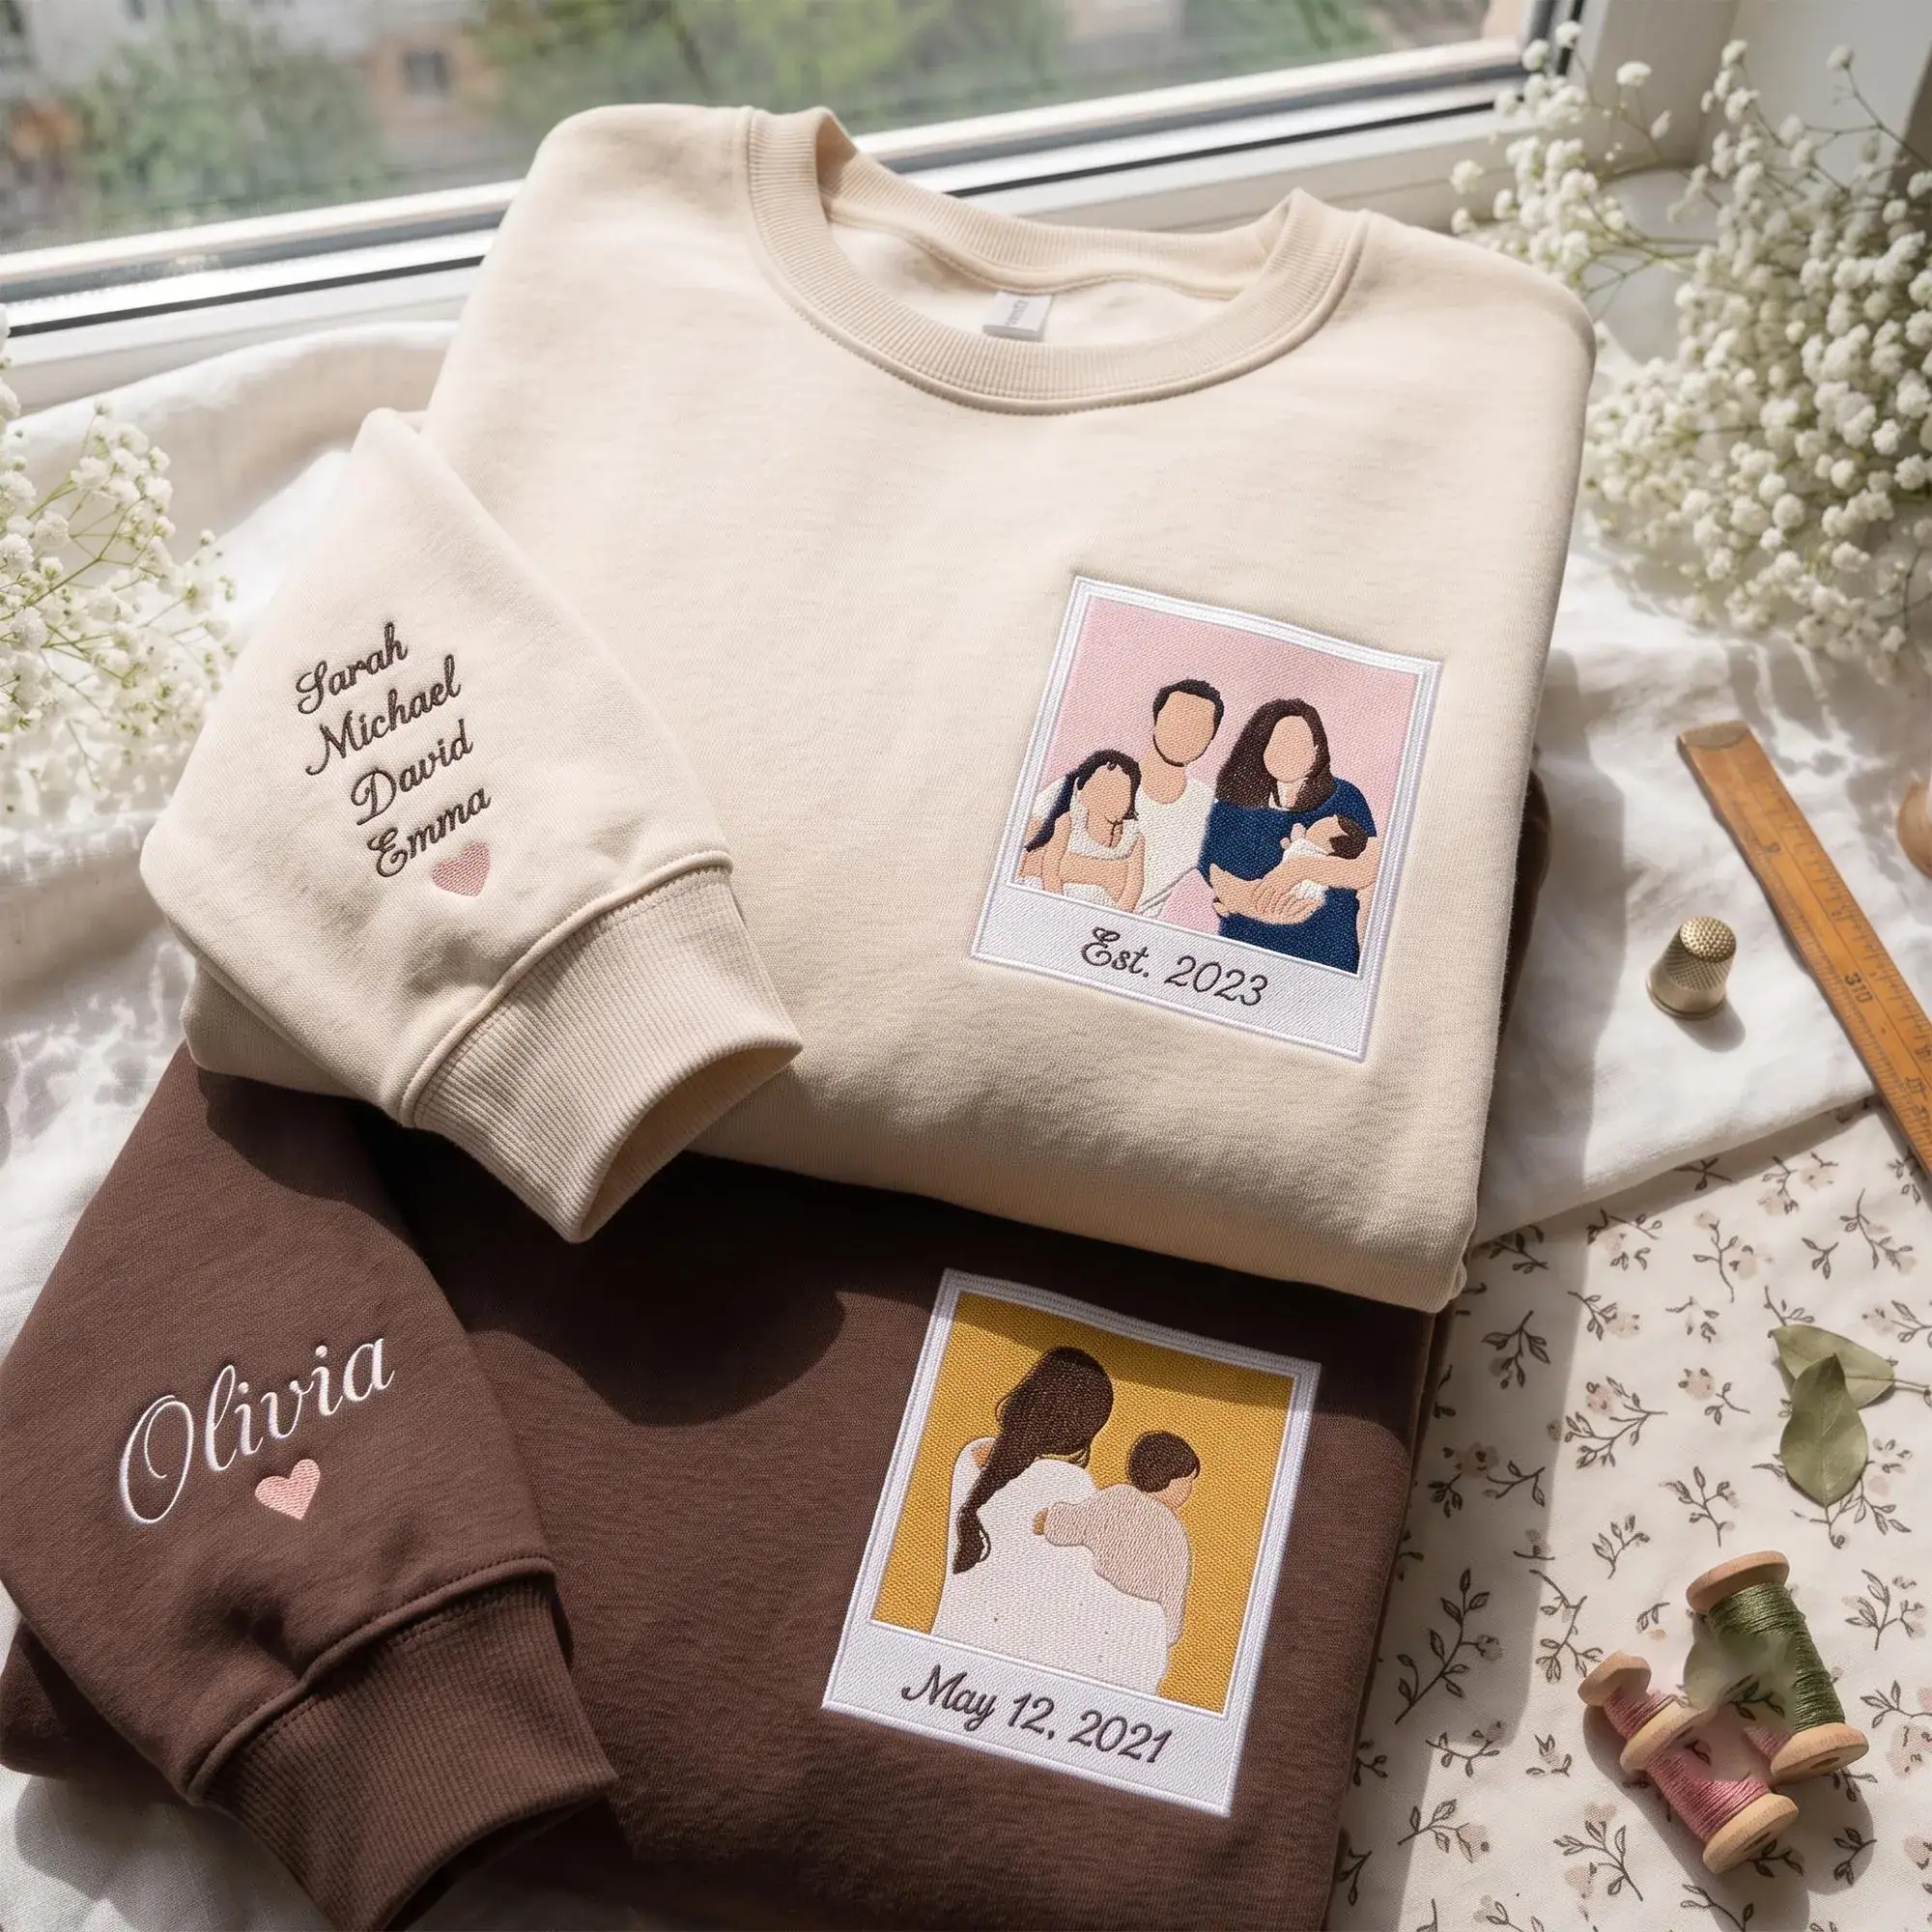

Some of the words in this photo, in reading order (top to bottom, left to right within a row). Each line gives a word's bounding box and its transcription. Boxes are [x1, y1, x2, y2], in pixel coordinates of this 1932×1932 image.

[296, 621, 408, 714] Sarah
[305, 654, 461, 775] Michael
[351, 718, 473, 826] David
[367, 788, 492, 877] Emma
[1080, 926, 1150, 979] Est.
[1164, 954, 1268, 1007] 2023
[119, 1338, 395, 1523] Olivia
[901, 1664, 997, 1731] May
[1067, 1709, 1173, 1763] 2021
